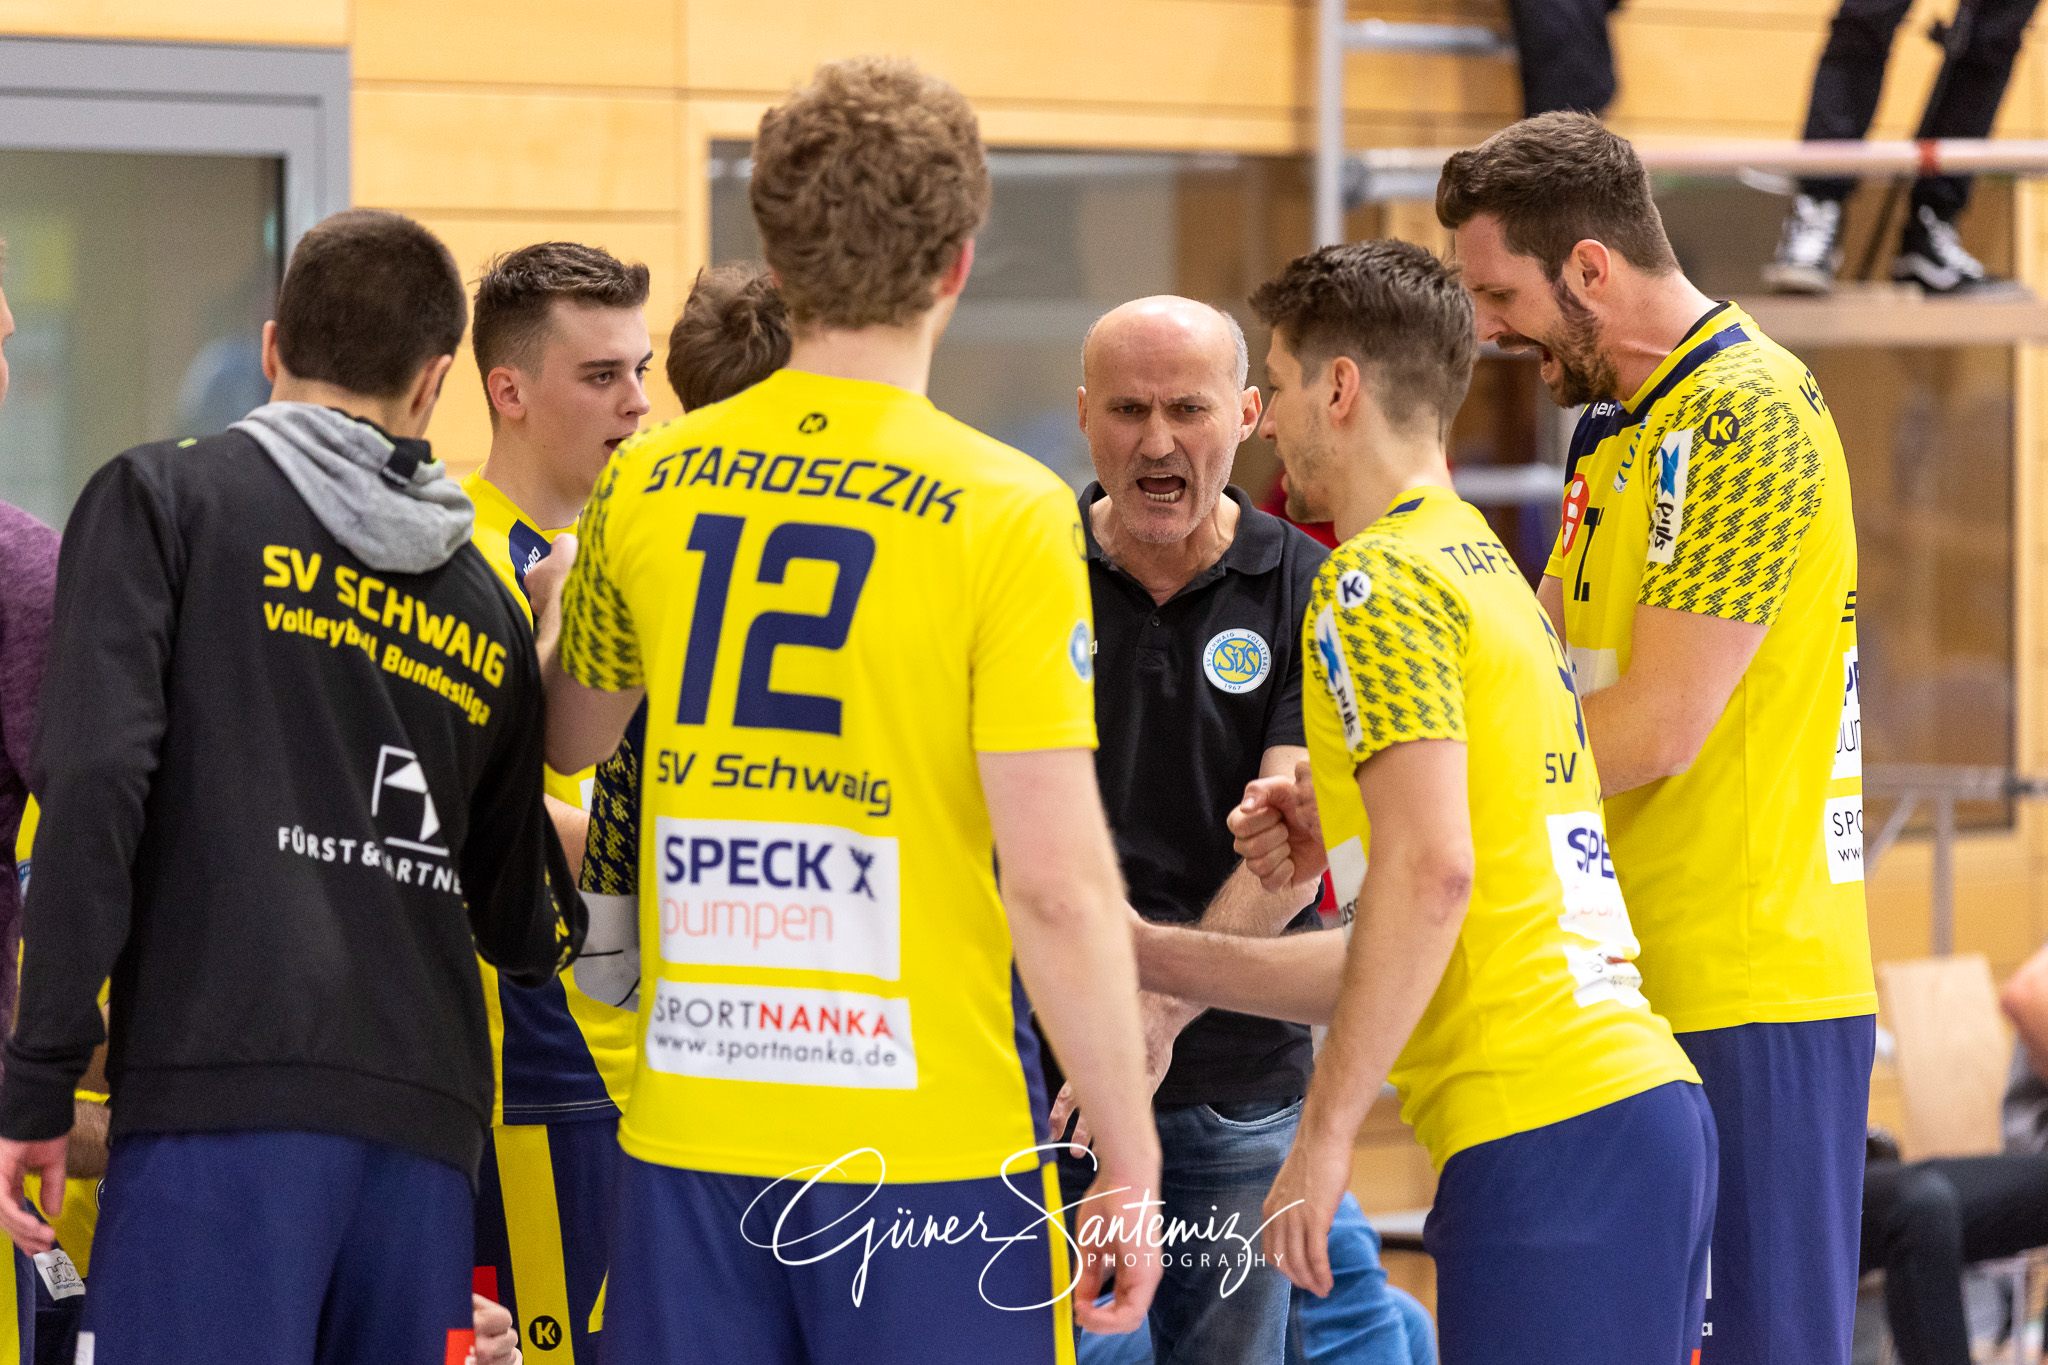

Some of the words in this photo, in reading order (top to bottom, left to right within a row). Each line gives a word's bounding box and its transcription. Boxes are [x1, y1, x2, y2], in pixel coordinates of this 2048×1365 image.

[643, 445, 966, 523] STAROSCZIK
[263, 545, 322, 592] SV
[334, 565, 507, 687] SCHWAIG
[676, 512, 876, 737] 12
[382, 644, 491, 727] Bundesliga
[658, 749, 697, 785] SV
[712, 754, 891, 817] Schwaig
[1545, 752, 1577, 783] SV
[277, 824, 357, 864] FÜRST
[665, 835, 834, 891] SPECK
[654, 995, 894, 1039] SPORTNANKA
[655, 1032, 897, 1068] www.sportnanka.de
